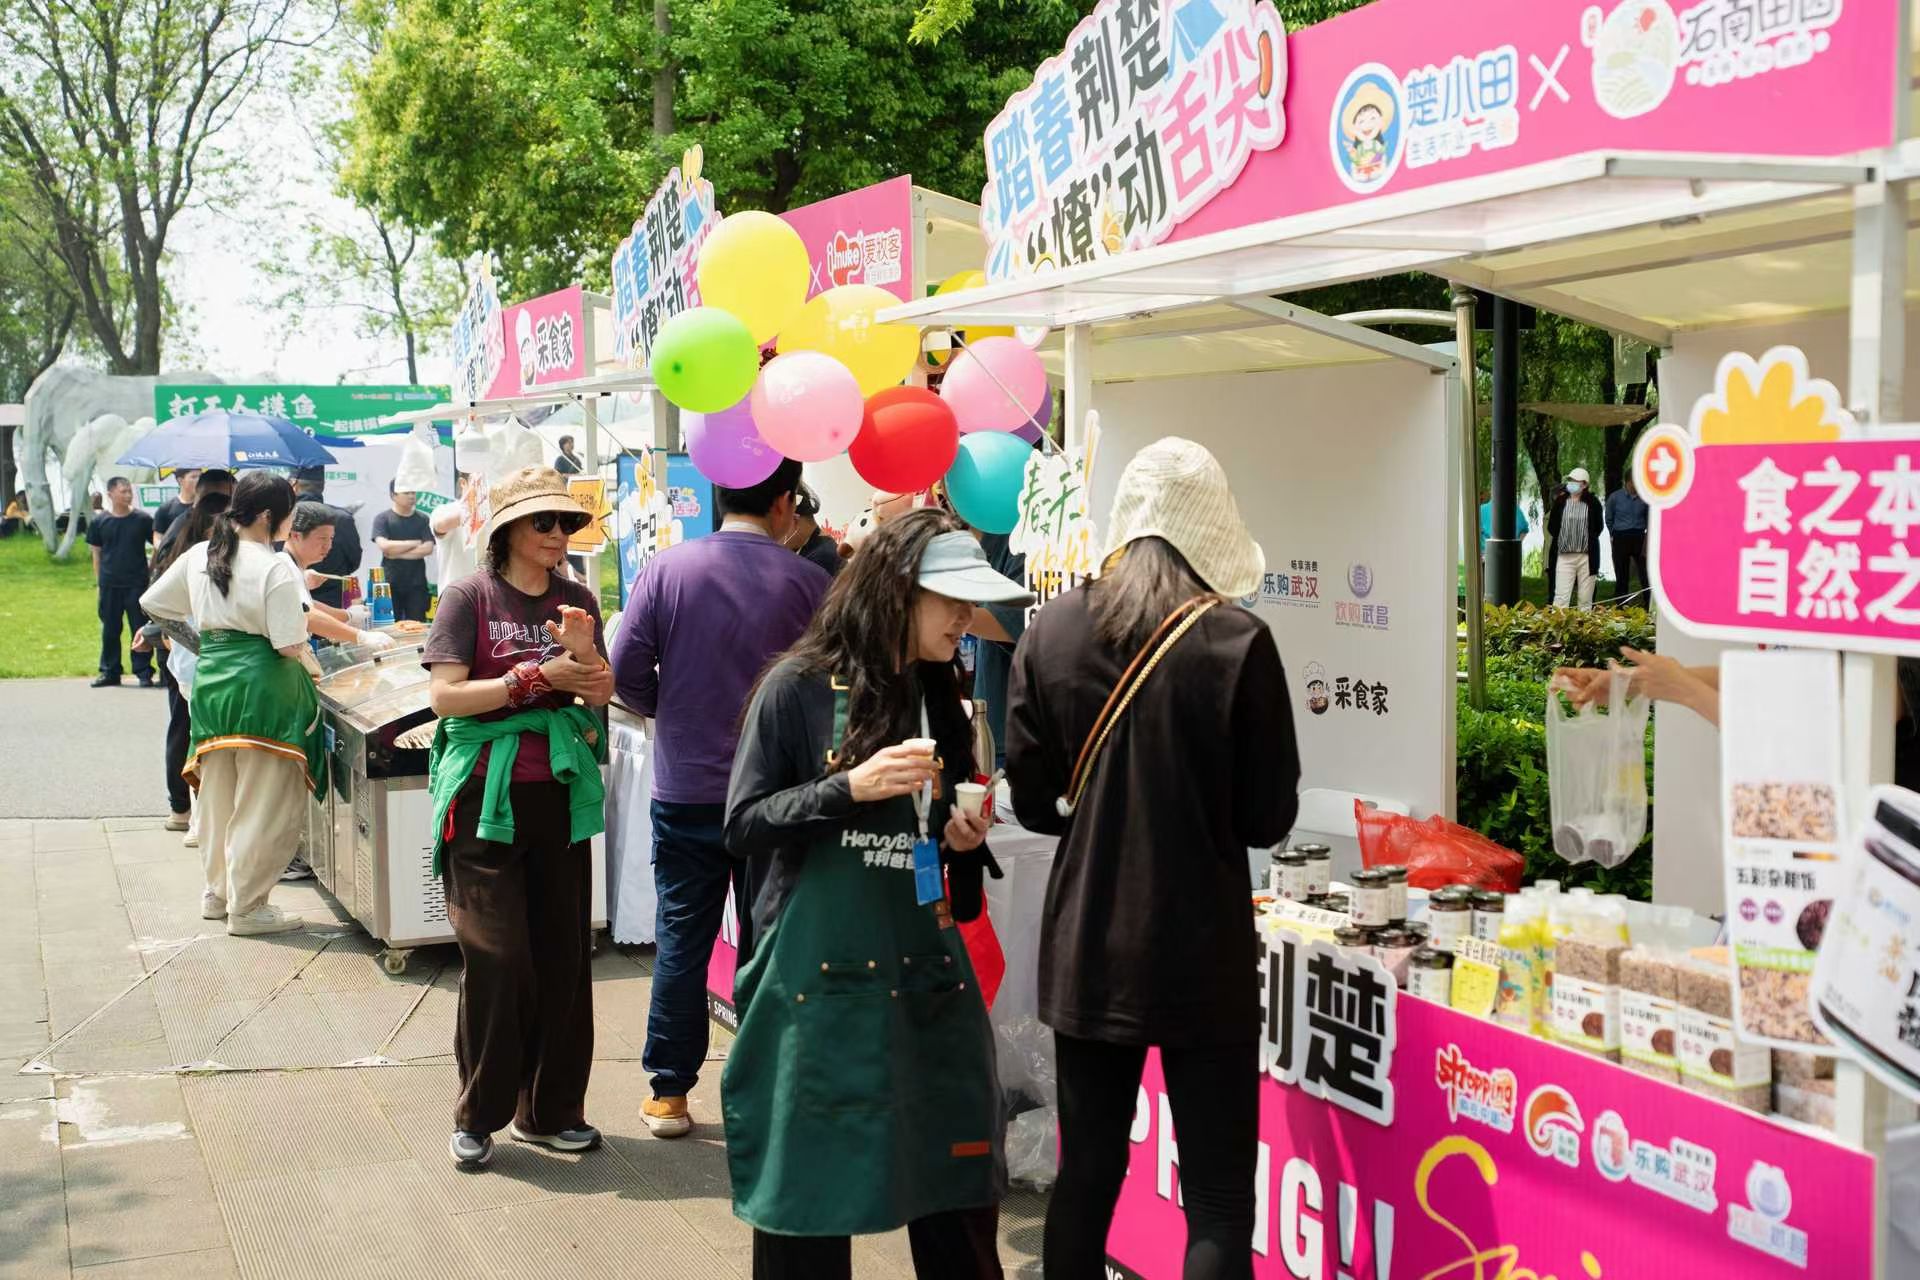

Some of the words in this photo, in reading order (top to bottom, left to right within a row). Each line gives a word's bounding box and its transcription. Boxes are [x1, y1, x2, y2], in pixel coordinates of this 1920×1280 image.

[1407, 54, 1512, 128] 楚小田
[615, 180, 685, 322] 踏春荆楚
[537, 315, 573, 371] 采食家
[1263, 573, 1319, 599] 乐购武汉
[1737, 539, 1920, 625] 自然之
[1335, 677, 1389, 715] 采食家
[713, 1001, 738, 1028] SPRING
